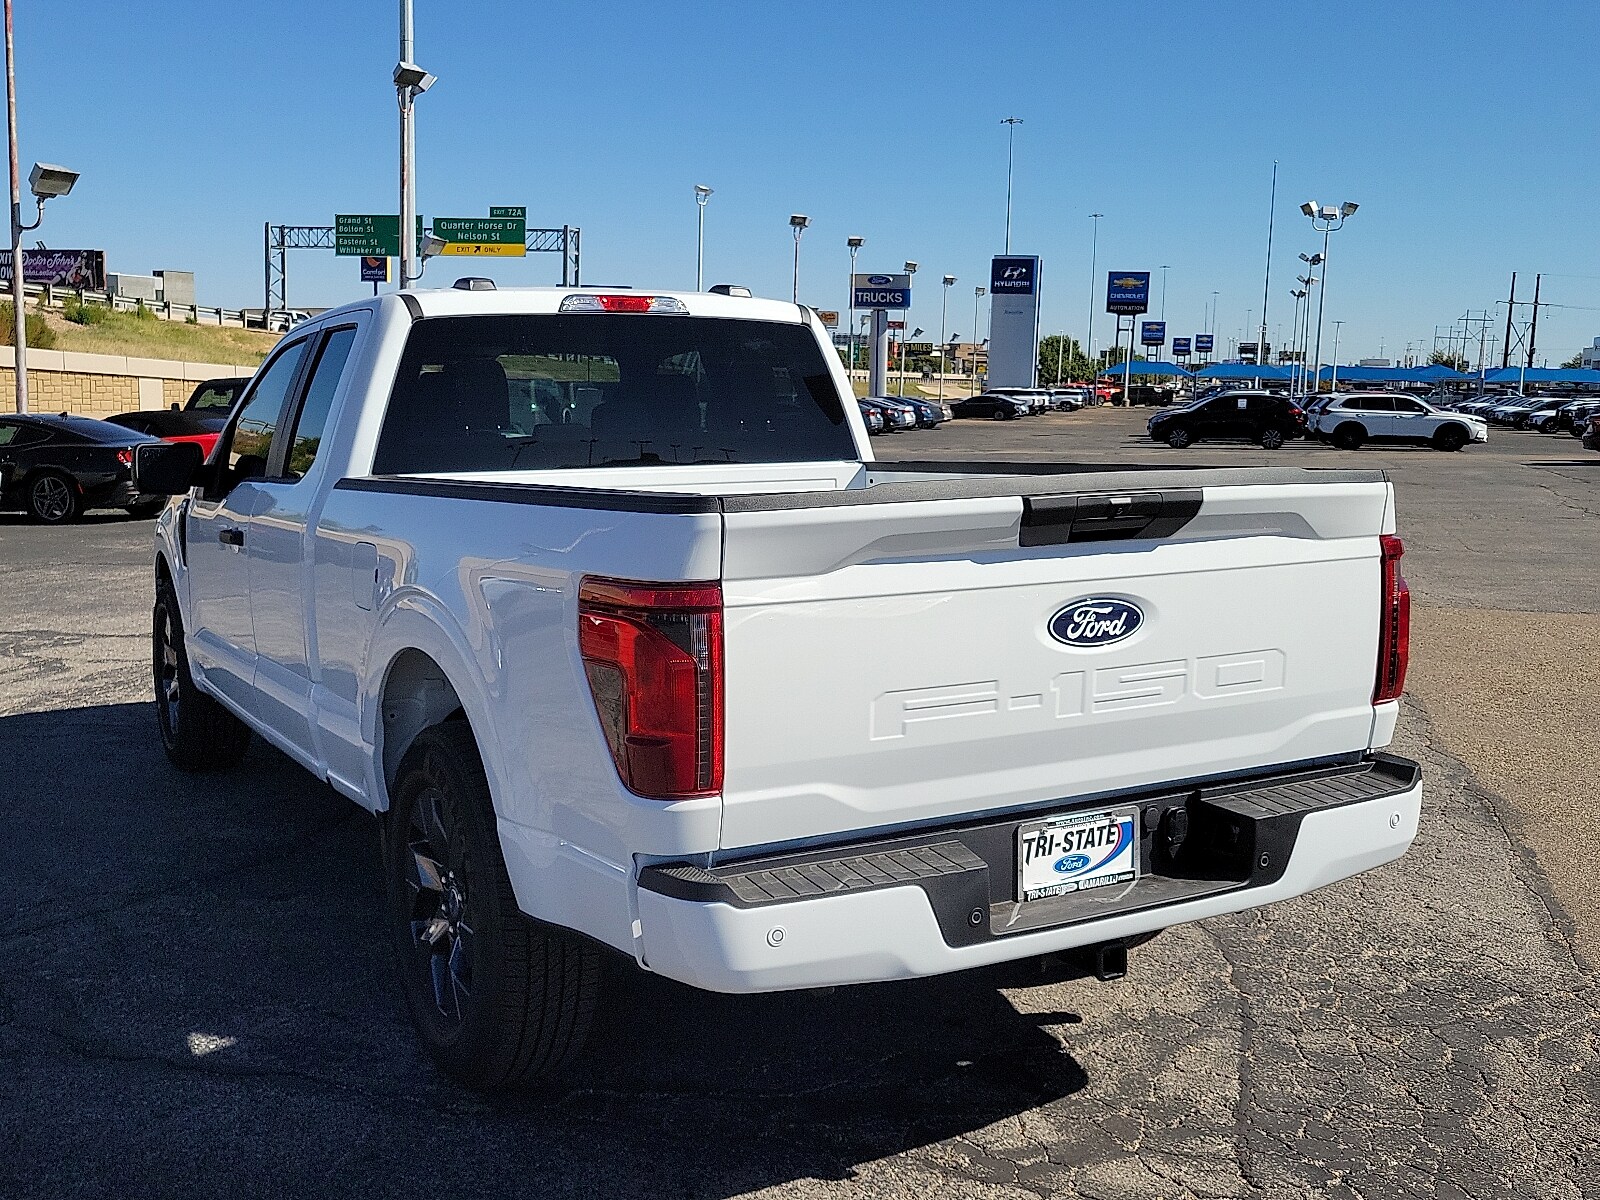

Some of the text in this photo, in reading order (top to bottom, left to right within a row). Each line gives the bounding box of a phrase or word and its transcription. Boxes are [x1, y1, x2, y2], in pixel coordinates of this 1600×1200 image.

[508, 208, 523, 217] 72A
[339, 217, 373, 225] Grand St
[440, 221, 517, 230] Quarter Horse Dr
[339, 225, 375, 233] Bolton St
[457, 232, 501, 240] Nelson St
[339, 238, 367, 246] Eastern
[375, 247, 386, 255] Rd
[0, 252, 13, 265] XIT
[994, 280, 1030, 288] HYUNDAI
[856, 292, 903, 303] TRUCKS
[911, 343, 932, 352] MILES
[1067, 606, 1127, 639] Ford
[870, 648, 1287, 741] F-150
[1023, 824, 1117, 867] TRI-STATE
[1060, 856, 1084, 871] Ford
